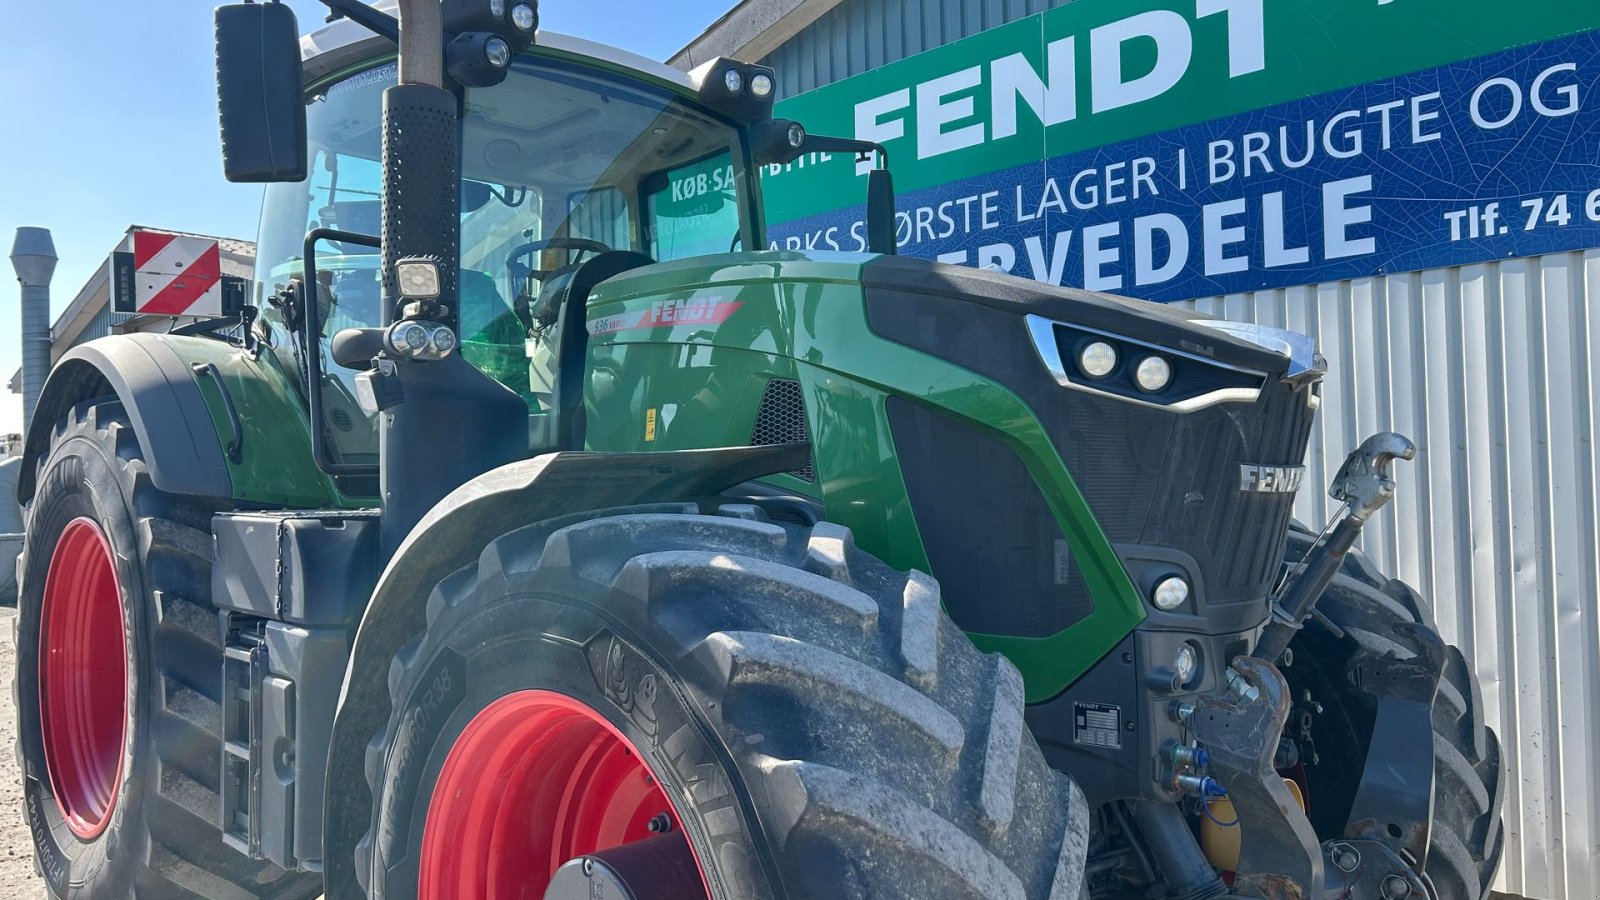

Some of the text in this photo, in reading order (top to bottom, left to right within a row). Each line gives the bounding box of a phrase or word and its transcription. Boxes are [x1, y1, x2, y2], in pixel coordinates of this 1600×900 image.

[855, 0, 1267, 176] FENDT
[850, 188, 1000, 253] SØRSTE
[1016, 157, 1159, 222] LAGER
[1178, 148, 1186, 190] I
[1208, 92, 1441, 184] BRUGTE
[1470, 63, 1579, 129] OG
[938, 175, 1376, 291] VEDELE
[1444, 203, 1508, 241] Tlf.
[1521, 194, 1572, 232] 74
[594, 319, 609, 332] 936
[651, 296, 722, 322] FENDT
